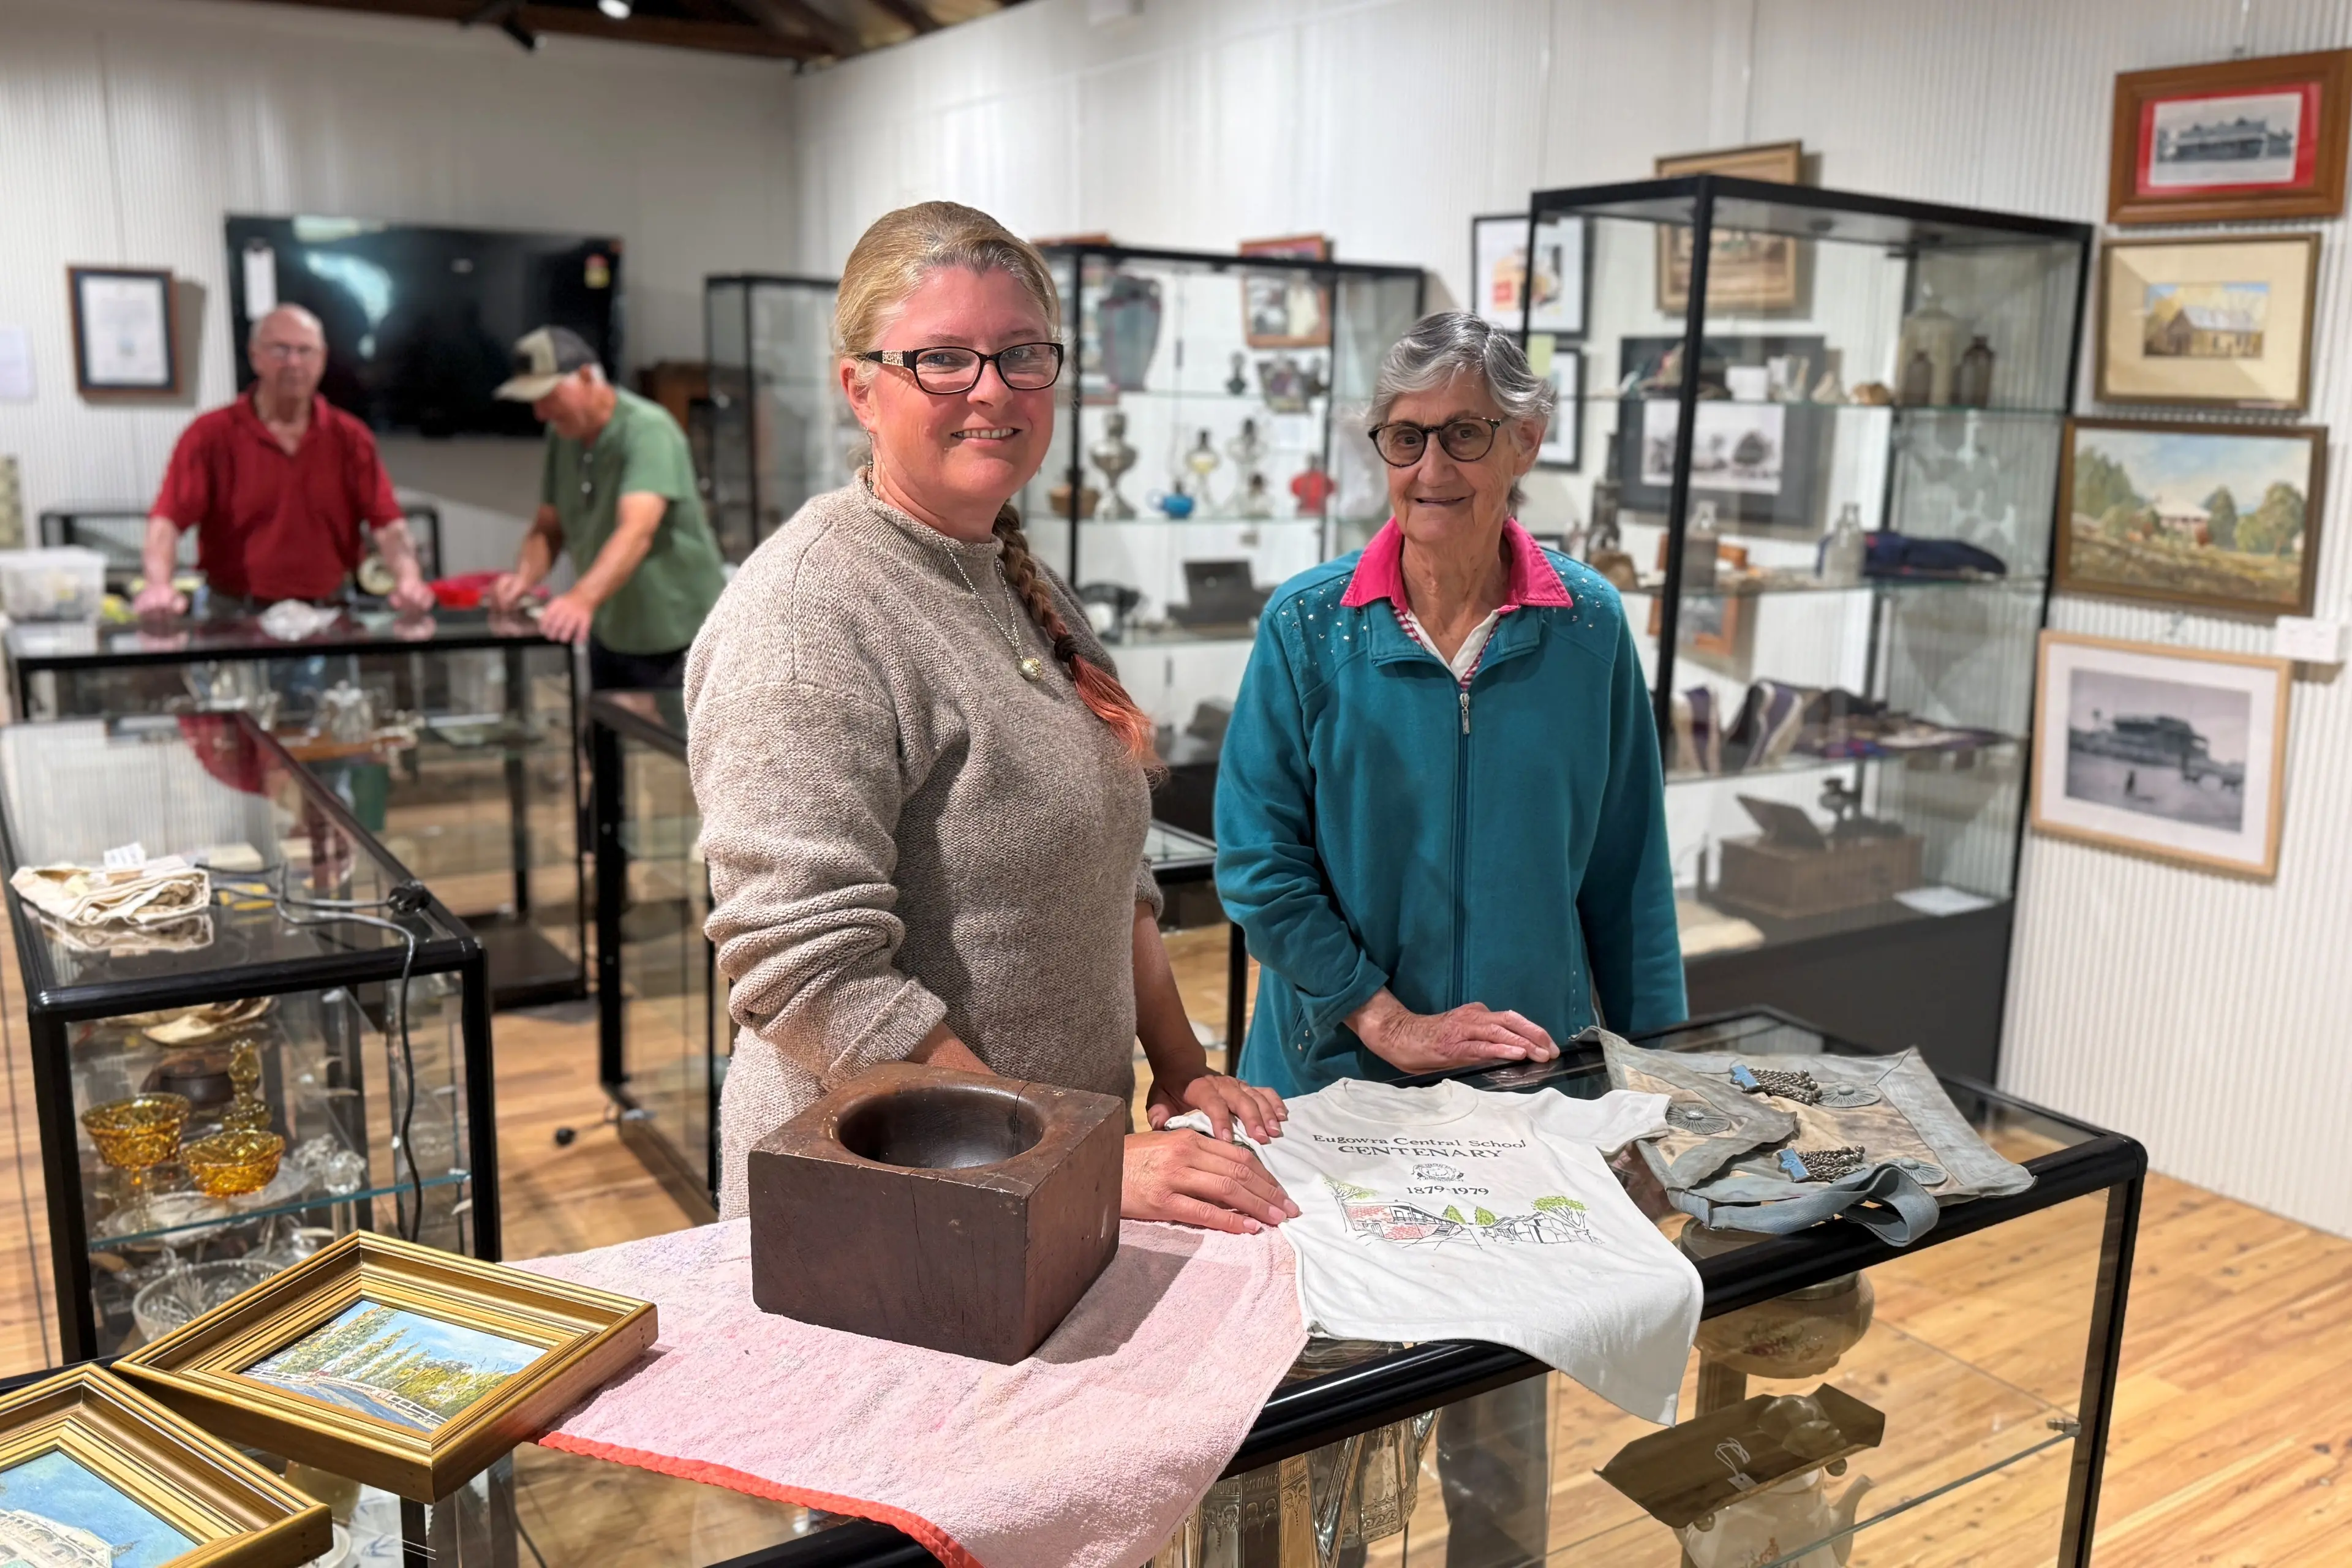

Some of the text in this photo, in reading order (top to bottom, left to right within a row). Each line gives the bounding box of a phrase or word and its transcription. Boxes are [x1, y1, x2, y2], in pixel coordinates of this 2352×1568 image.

[1312, 1134, 1526, 1148] Eugowra Central School
[1338, 1145, 1502, 1158] CENTENARY
